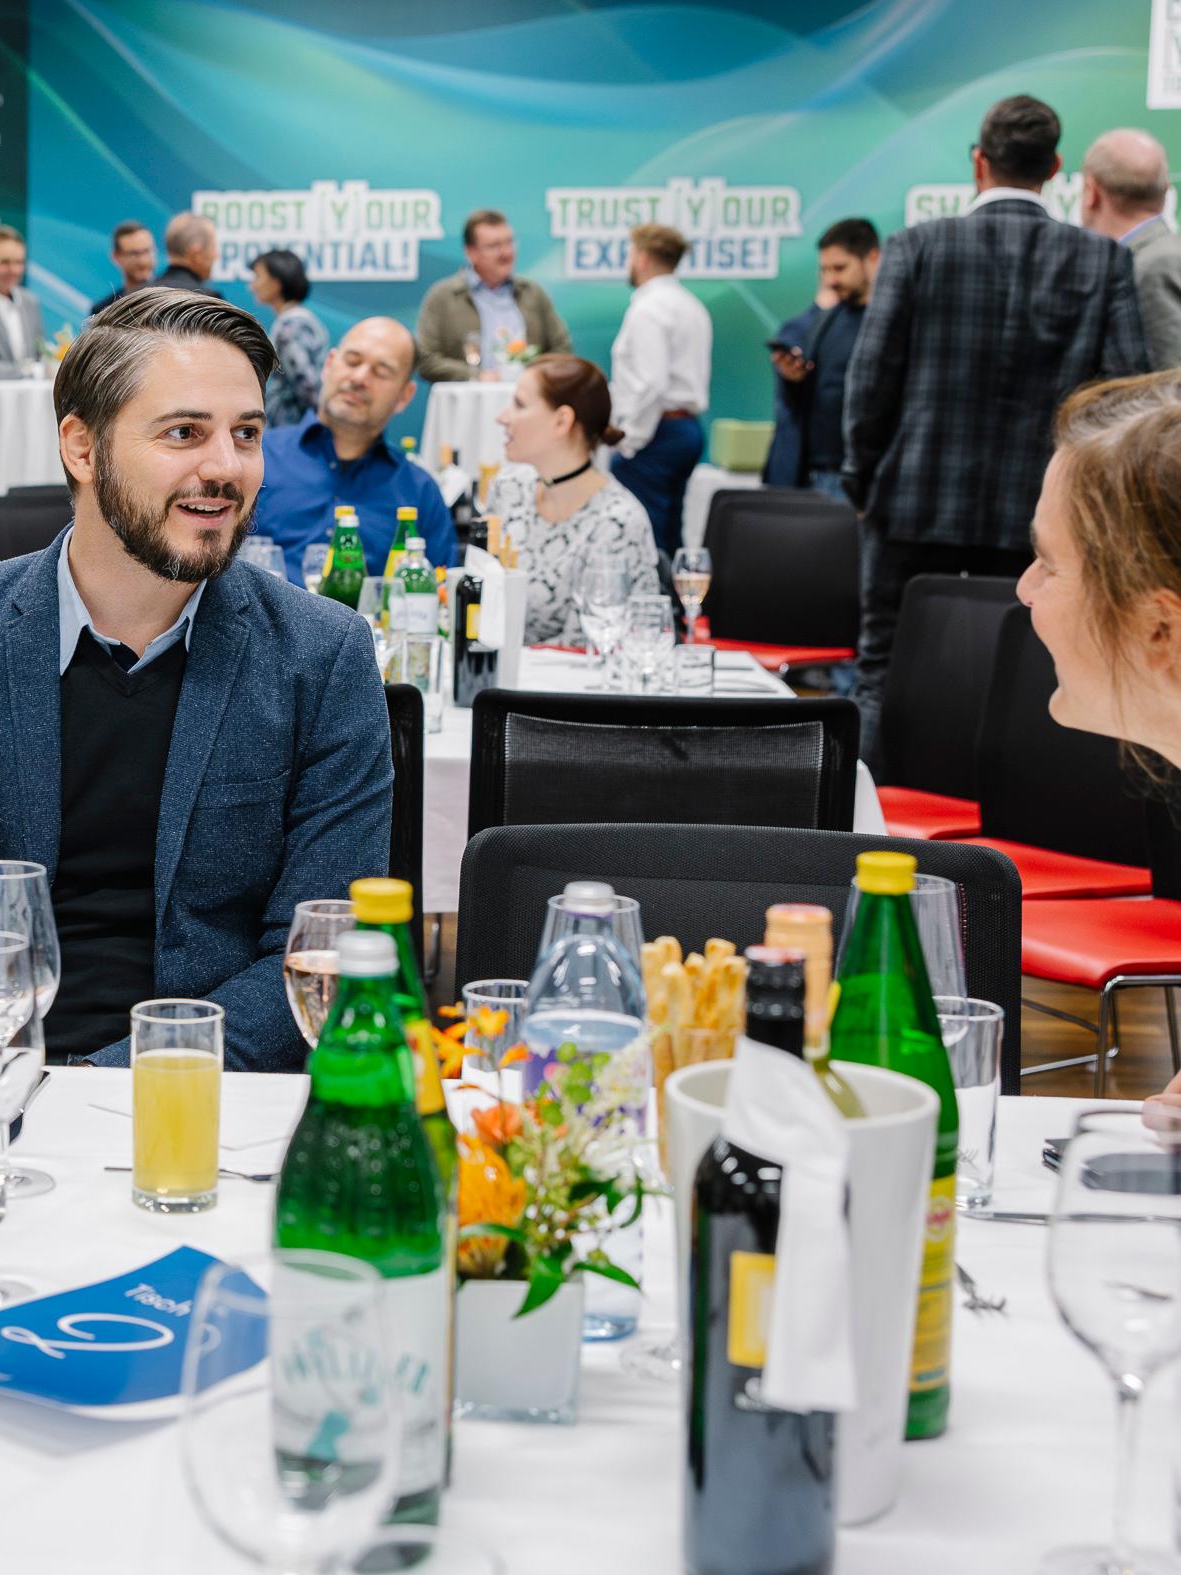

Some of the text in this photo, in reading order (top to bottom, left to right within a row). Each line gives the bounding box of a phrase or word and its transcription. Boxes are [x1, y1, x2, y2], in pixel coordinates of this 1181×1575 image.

[202, 199, 306, 231] BOOST
[559, 196, 661, 228] TRUST
[124, 1283, 192, 1317] Tisch
